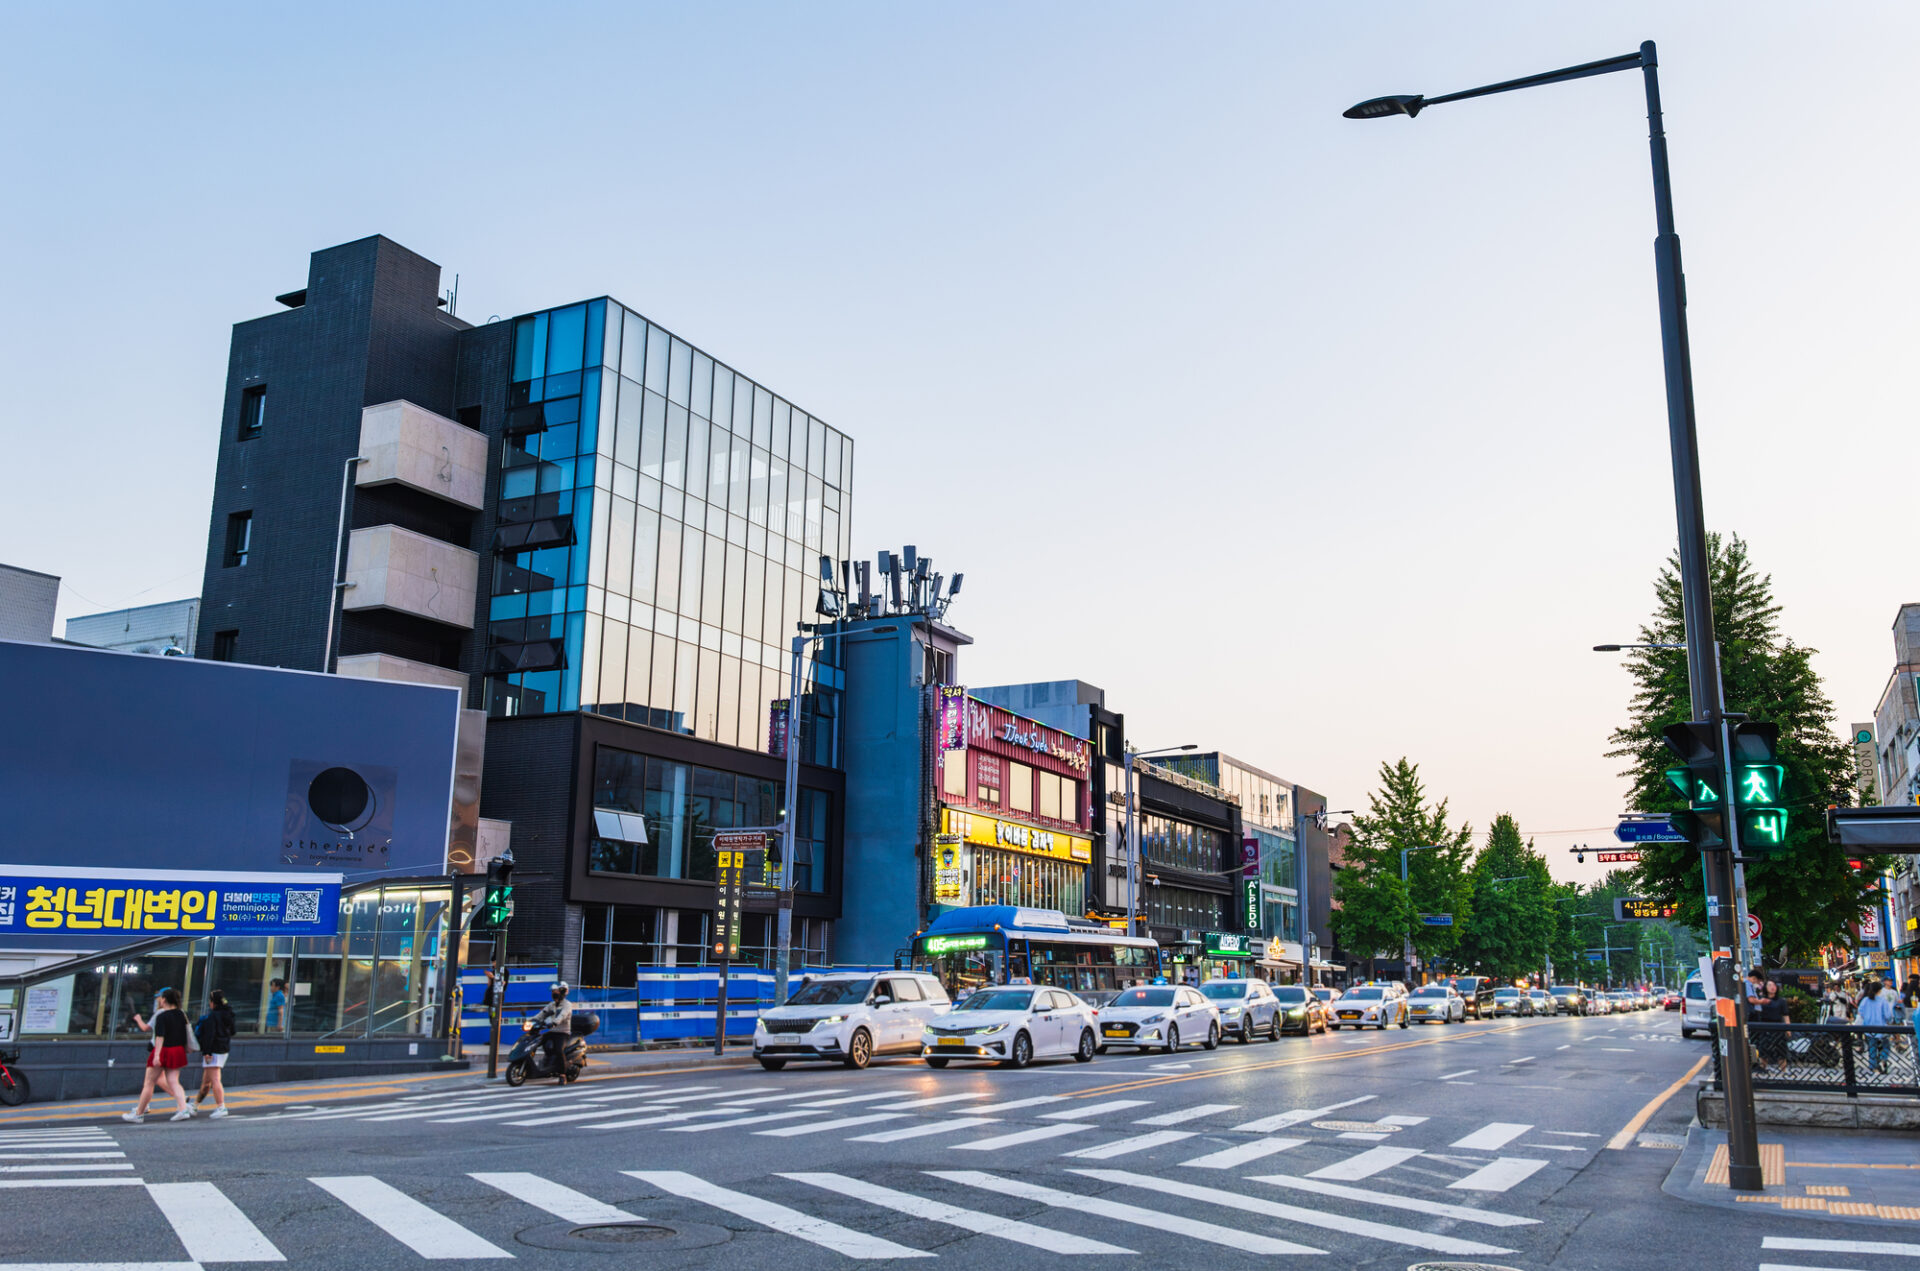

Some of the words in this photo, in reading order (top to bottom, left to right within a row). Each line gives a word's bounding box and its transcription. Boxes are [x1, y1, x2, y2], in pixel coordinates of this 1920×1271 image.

[1861, 750, 1875, 788] NORT
[1759, 815, 1779, 843] 4
[285, 840, 388, 854] otherside
[721, 870, 727, 879] 4
[26, 885, 217, 930] 청년대변인
[223, 892, 281, 903] 더불어민주당
[1247, 880, 1258, 929] ALPEDO
[222, 904, 280, 913] theminjoo.kr
